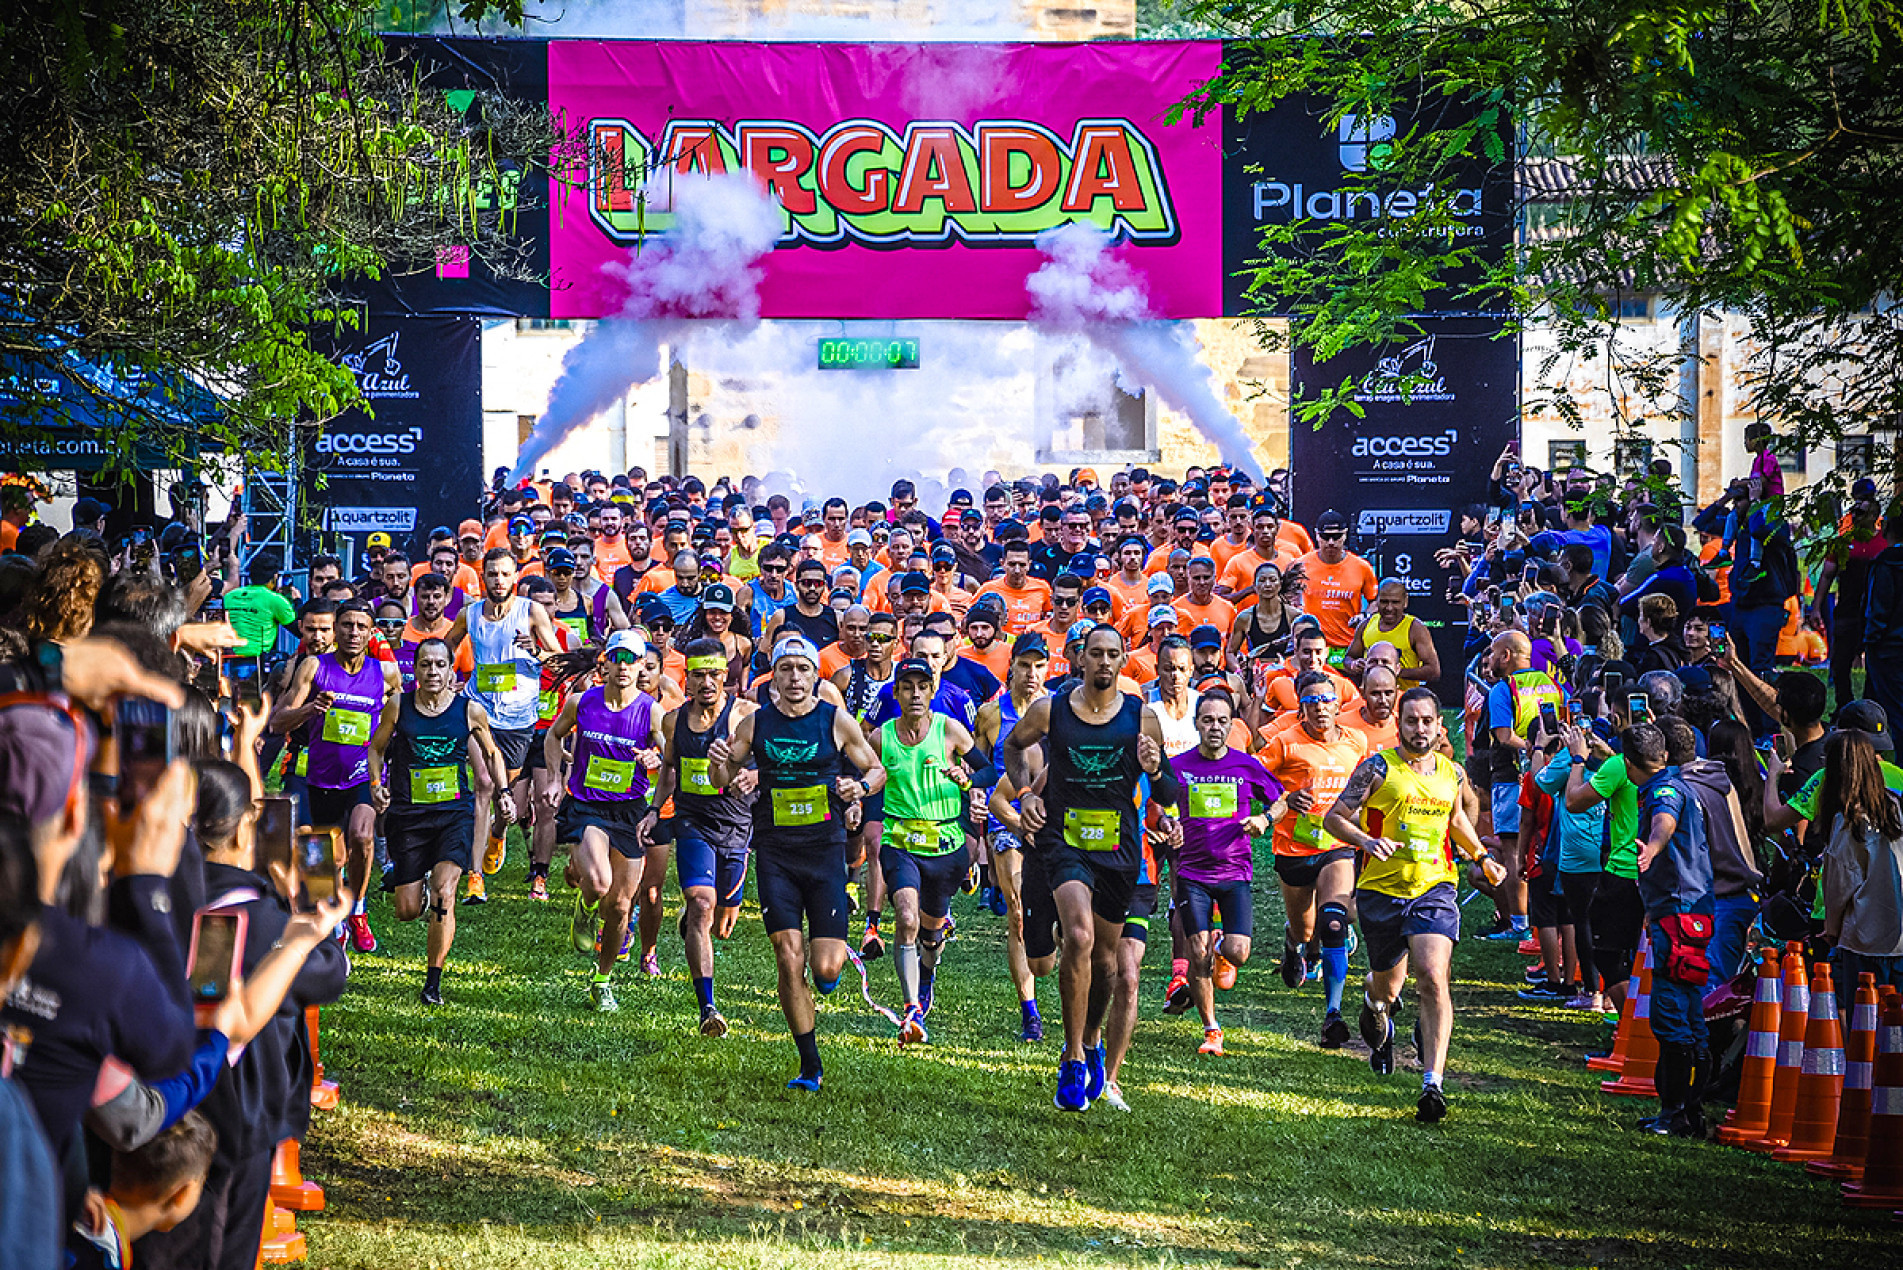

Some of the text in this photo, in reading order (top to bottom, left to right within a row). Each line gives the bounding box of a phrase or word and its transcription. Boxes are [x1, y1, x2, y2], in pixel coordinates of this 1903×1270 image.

[590, 120, 1175, 240] LARGADA
[821, 341, 916, 364] 00:00:07
[362, 373, 412, 391] Azul
[314, 433, 416, 454] access
[1351, 436, 1452, 457] access
[337, 456, 345, 466] A
[345, 458, 370, 467] casa
[379, 457, 402, 467] sua.
[1373, 459, 1381, 469] A
[1382, 461, 1406, 470] casa
[1414, 460, 1436, 469] sua.
[370, 471, 415, 481] Planeta
[1406, 475, 1450, 483] Planeta
[341, 510, 410, 525] quartzolit
[1377, 513, 1445, 528] quartzolit
[338, 724, 357, 736] 571
[601, 772, 622, 784] 570
[426, 781, 447, 794] 591
[1205, 797, 1222, 808] 48
[1080, 827, 1105, 840] 228
